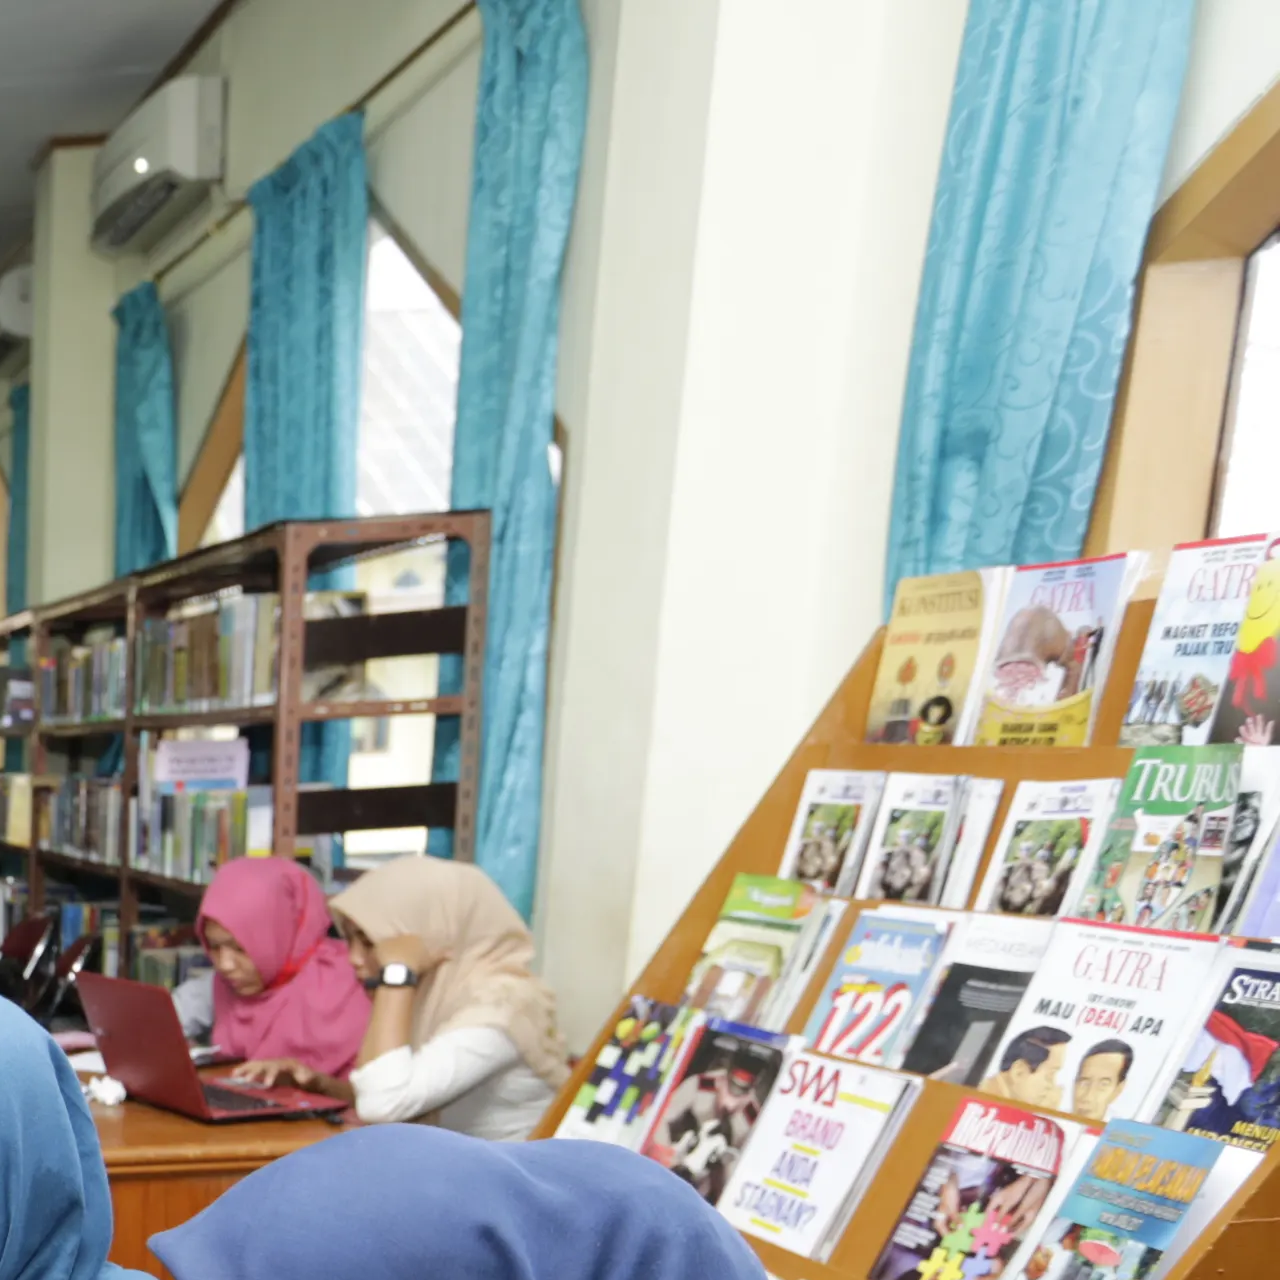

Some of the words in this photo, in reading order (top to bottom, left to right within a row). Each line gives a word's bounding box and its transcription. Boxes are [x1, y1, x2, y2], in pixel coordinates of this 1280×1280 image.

[1186, 563, 1257, 603] GATR
[1160, 623, 1209, 641] MAGNET
[1210, 622, 1239, 639] REFO
[1172, 642, 1210, 657] PAJAK
[1210, 640, 1236, 656] TRU
[1129, 757, 1240, 803] TRUBUS
[1072, 944, 1168, 992] GATRA
[1033, 997, 1076, 1020] MAU
[1076, 1004, 1129, 1034] (DEAL)
[1129, 1015, 1164, 1037] APA
